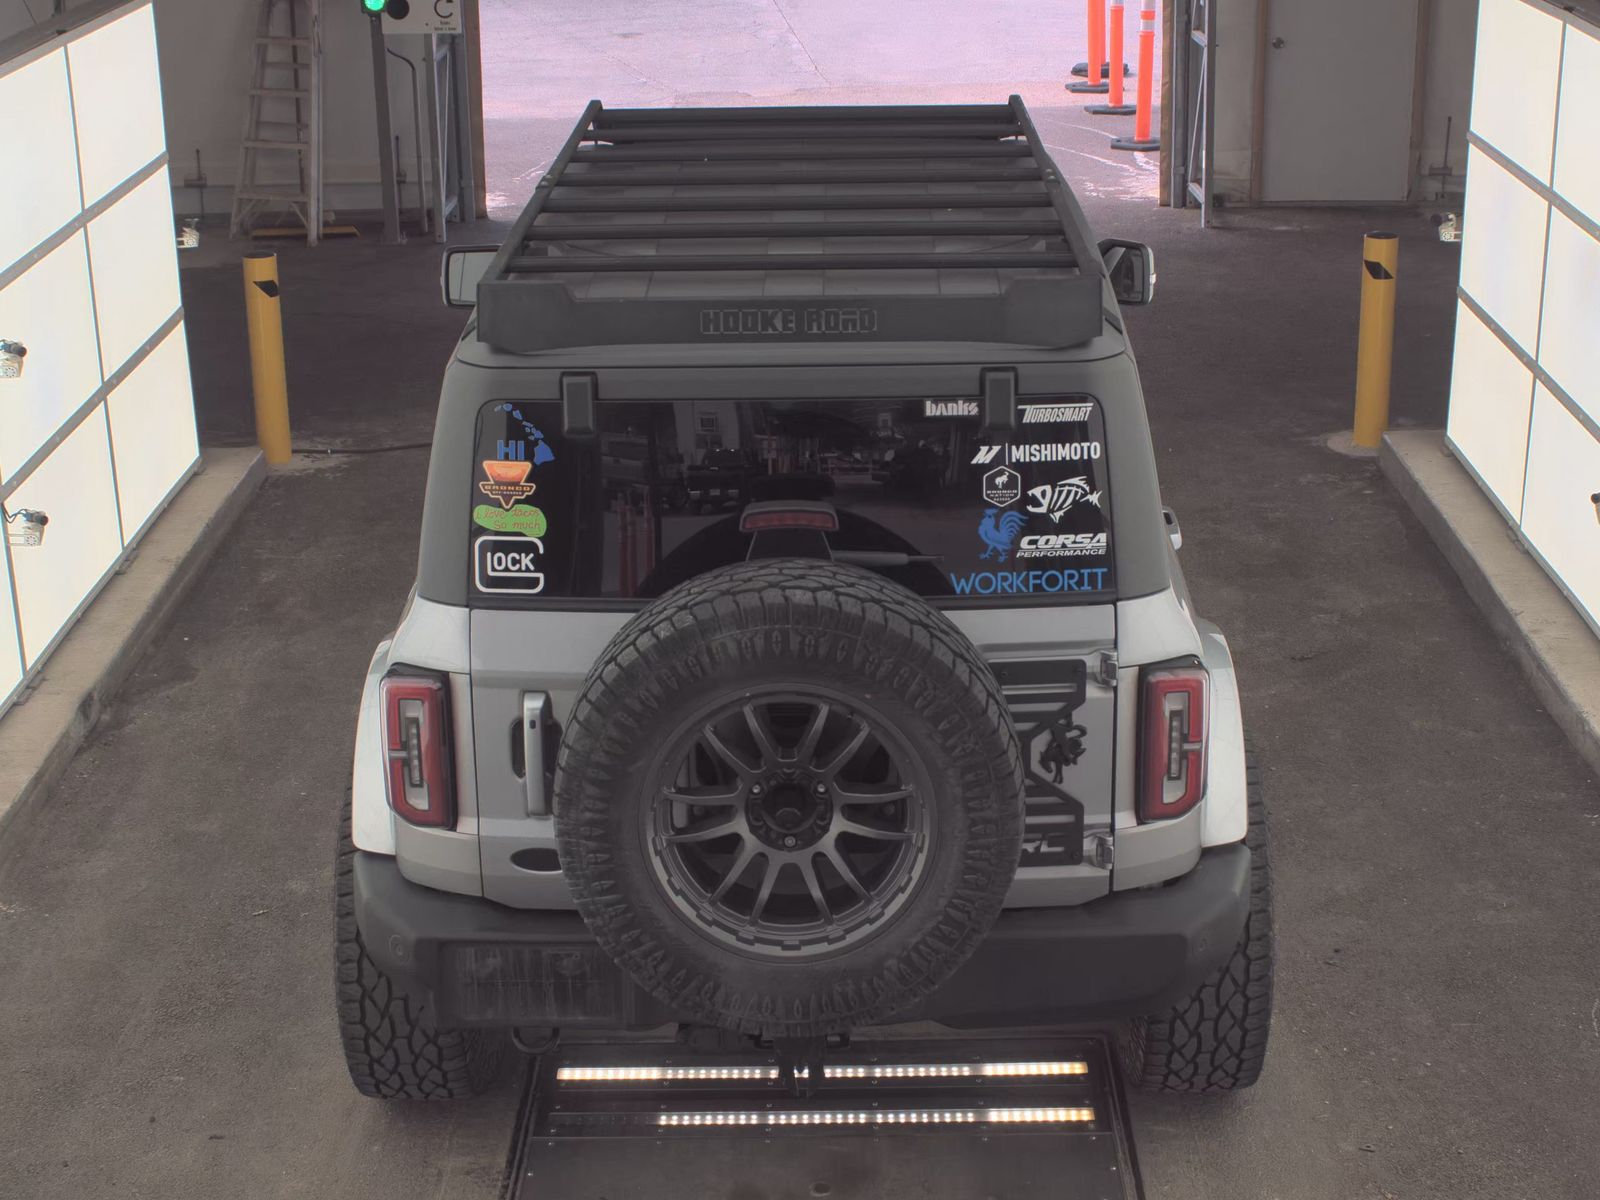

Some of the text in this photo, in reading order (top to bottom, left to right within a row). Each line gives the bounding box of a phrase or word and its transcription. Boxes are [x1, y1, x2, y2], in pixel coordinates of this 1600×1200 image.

[700, 307, 878, 334] HOOKE ROAD
[925, 400, 979, 416] banks
[1017, 402, 1094, 423] TURBOSMART
[497, 440, 525, 461] HI
[1011, 442, 1101, 463] MISHIMOTO
[1019, 533, 1107, 549] CORSA
[1016, 549, 1106, 558] PERFORMANCE
[951, 568, 1108, 594] WORKFORIT
